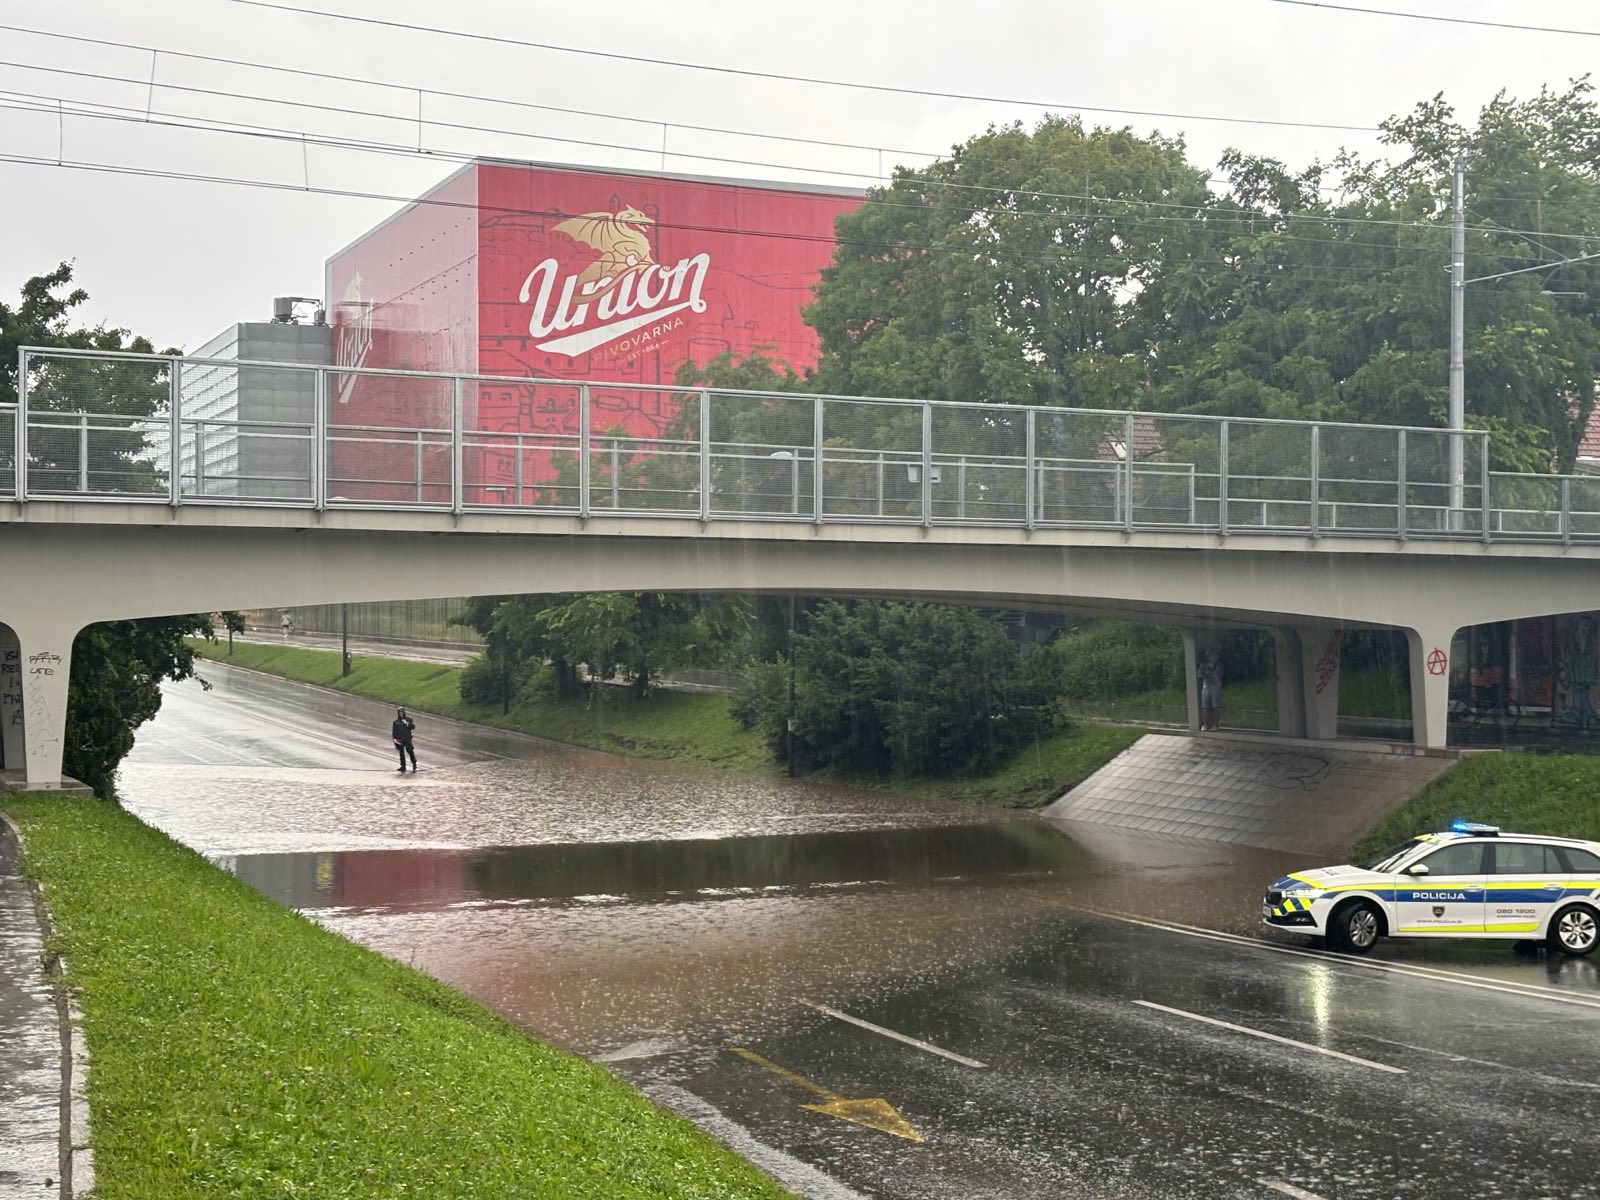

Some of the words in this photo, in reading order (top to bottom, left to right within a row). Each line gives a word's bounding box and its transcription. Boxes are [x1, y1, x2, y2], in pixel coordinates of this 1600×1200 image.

[519, 252, 711, 338] Union
[594, 317, 684, 362] PIVOVARNA
[1412, 892, 1466, 900] POLICIJA
